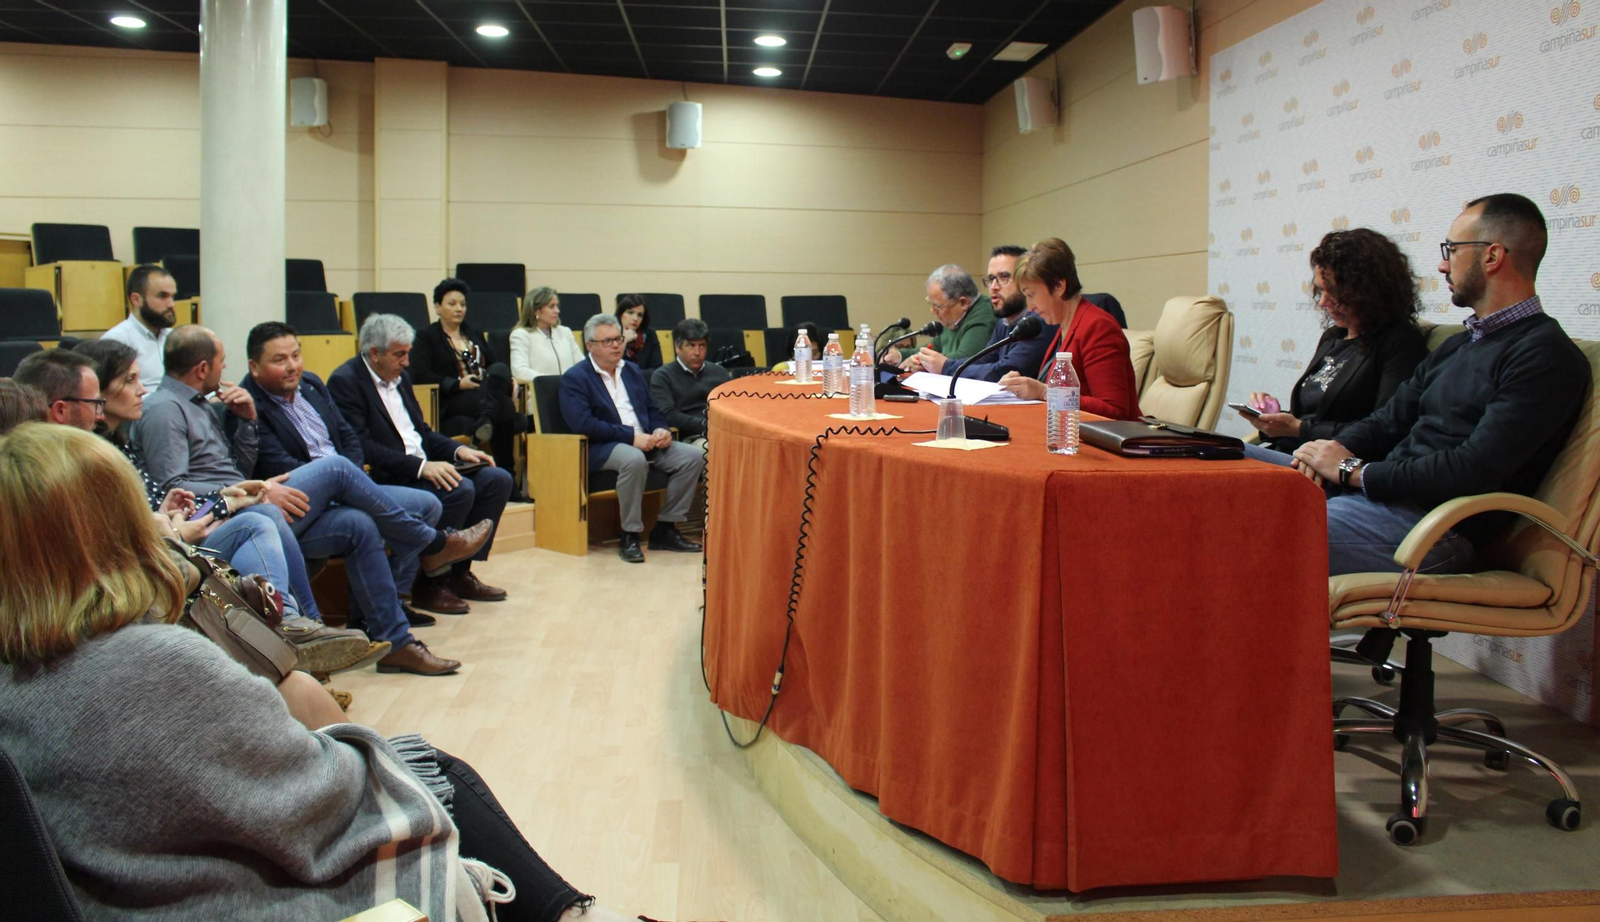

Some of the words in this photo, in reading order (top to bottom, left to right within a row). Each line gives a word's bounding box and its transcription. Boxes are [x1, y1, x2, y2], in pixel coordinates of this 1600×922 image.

[1539, 25, 1598, 53] campiñasur
[1454, 55, 1501, 79] campiñasur
[1487, 137, 1538, 158] campiñasur
[1410, 154, 1452, 172] campiñasur
[1545, 213, 1597, 233] ampiñasur
